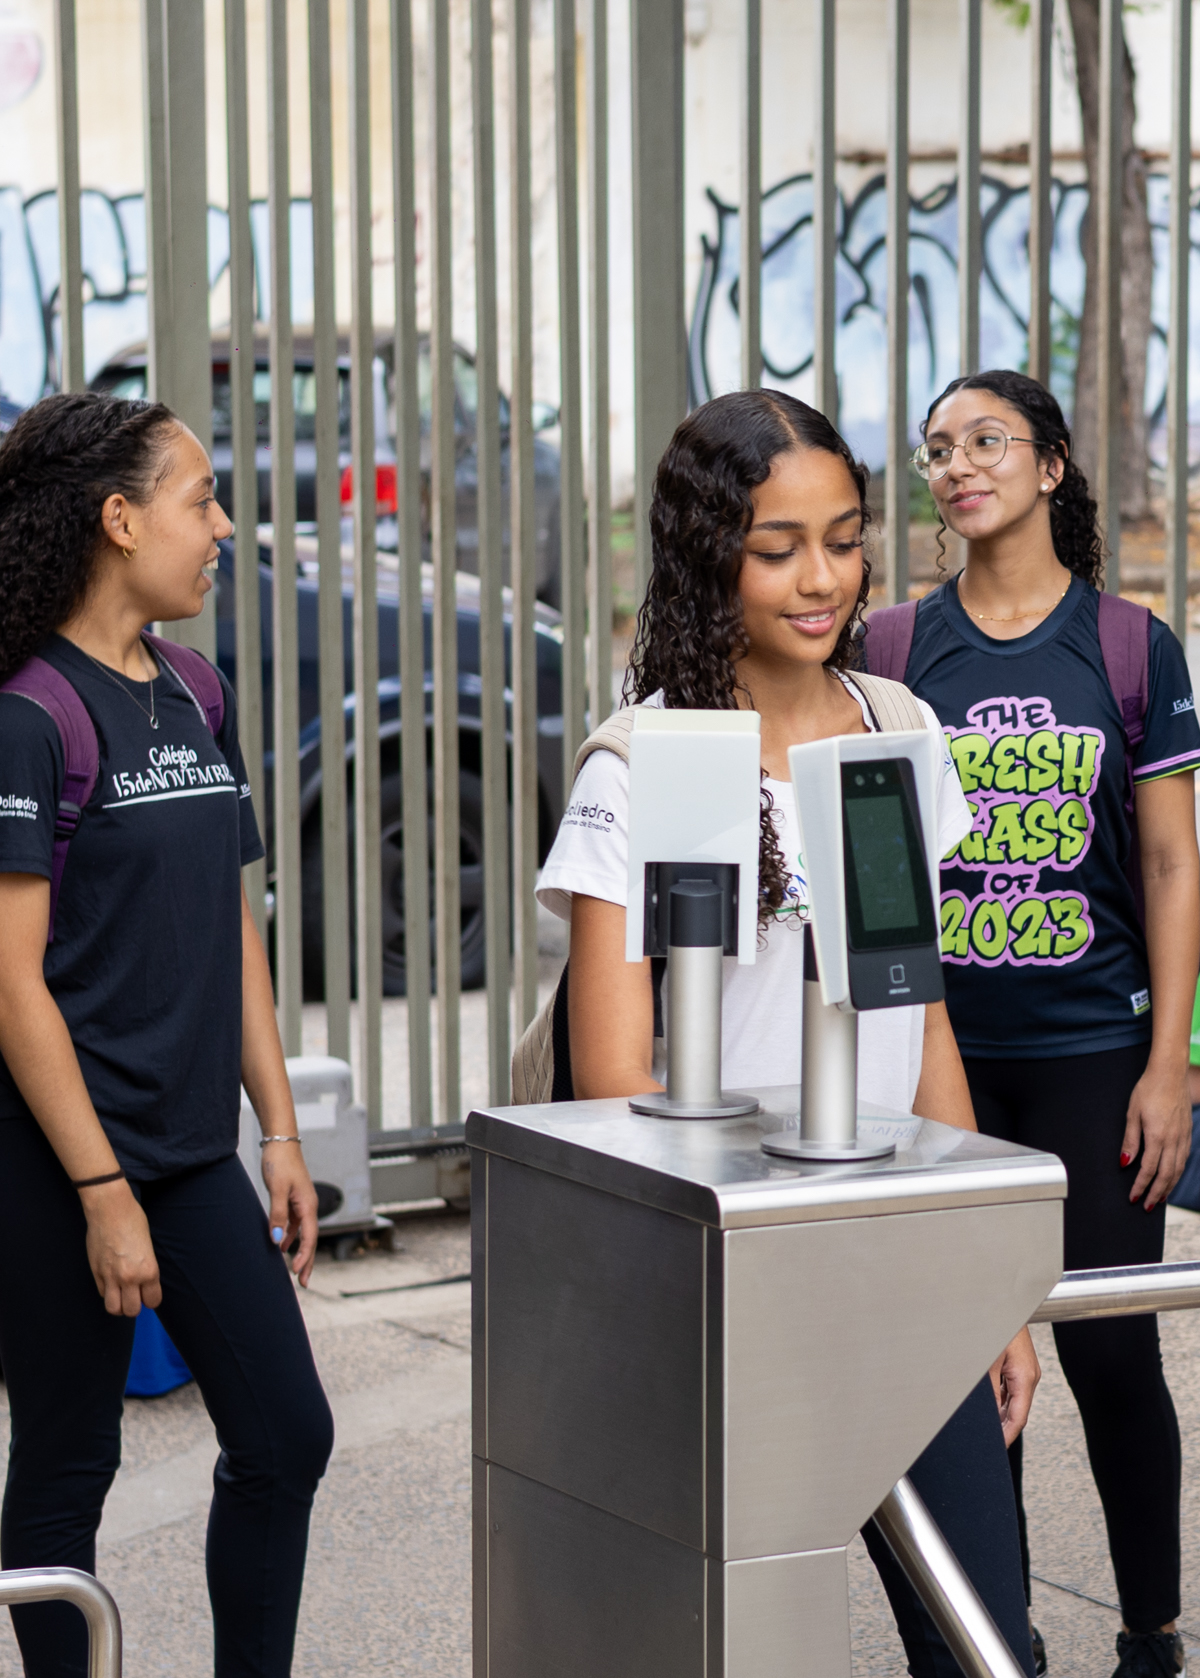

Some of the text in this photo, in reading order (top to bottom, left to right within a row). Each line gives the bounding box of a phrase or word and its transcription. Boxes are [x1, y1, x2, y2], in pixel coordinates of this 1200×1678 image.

[971, 702, 1049, 729] THE
[149, 744, 198, 769] Colégio
[943, 730, 1101, 796] RESH
[989, 872, 1034, 894] OF
[941, 896, 1090, 959] 2023
